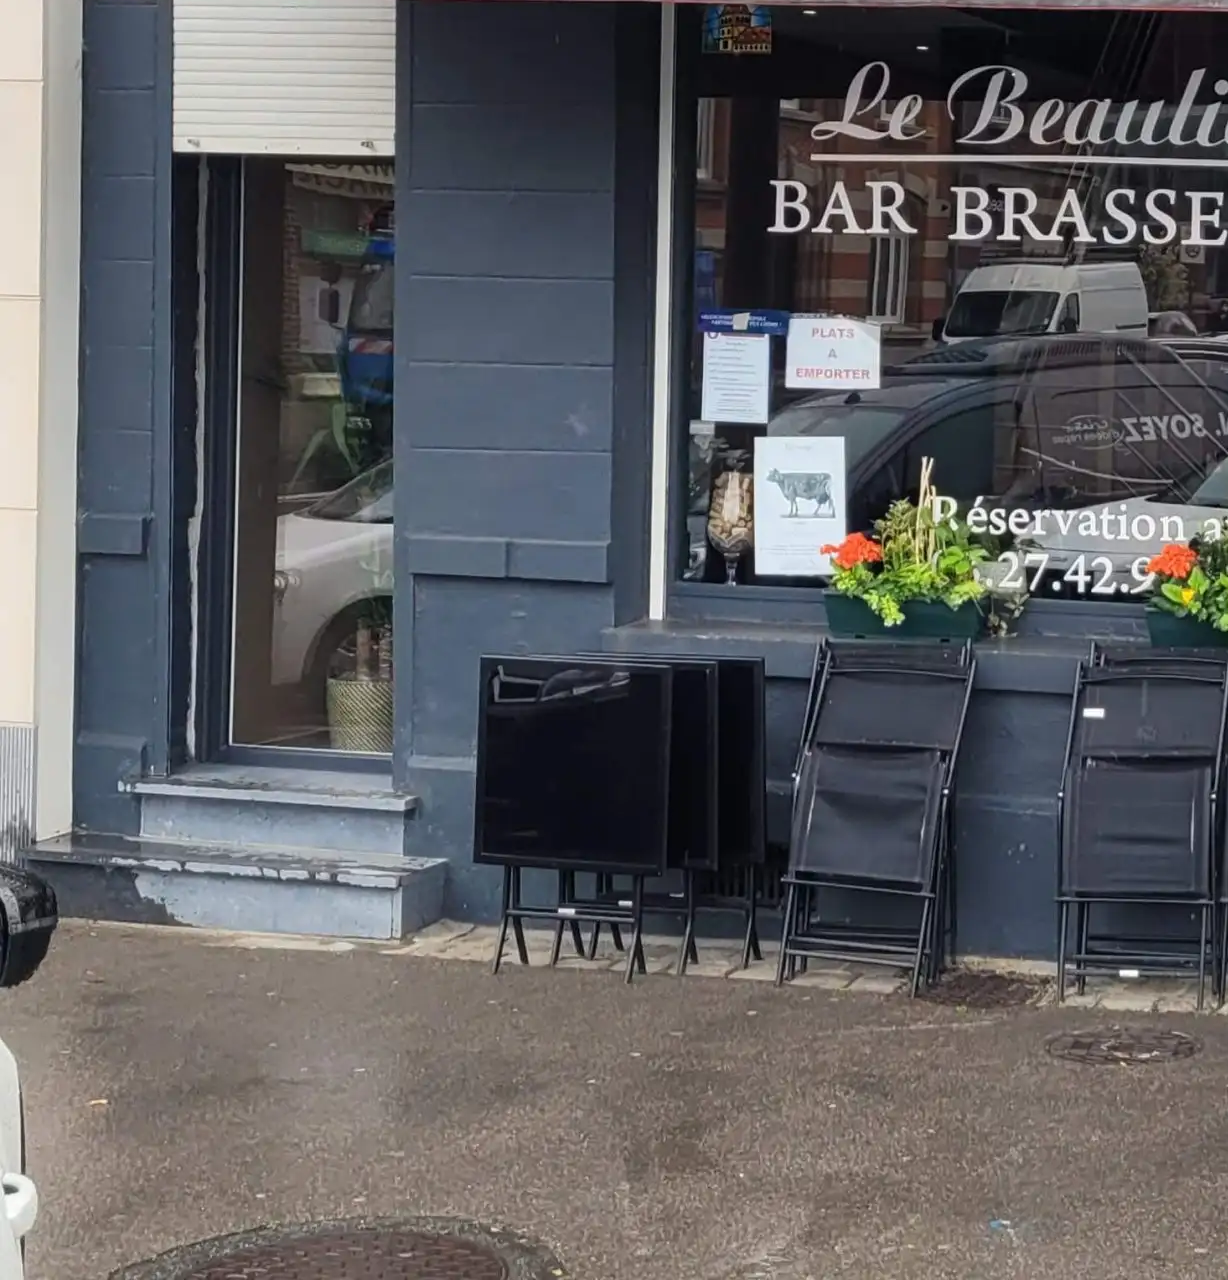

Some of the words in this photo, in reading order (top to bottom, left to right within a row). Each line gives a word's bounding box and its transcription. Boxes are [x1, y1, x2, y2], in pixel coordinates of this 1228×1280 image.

[810, 61, 927, 143] Le
[767, 180, 919, 235] BAR
[811, 327, 855, 339] PLATS
[827, 347, 838, 359] A
[795, 367, 871, 380] EMPORTER
[932, 496, 1188, 542] Réservation
